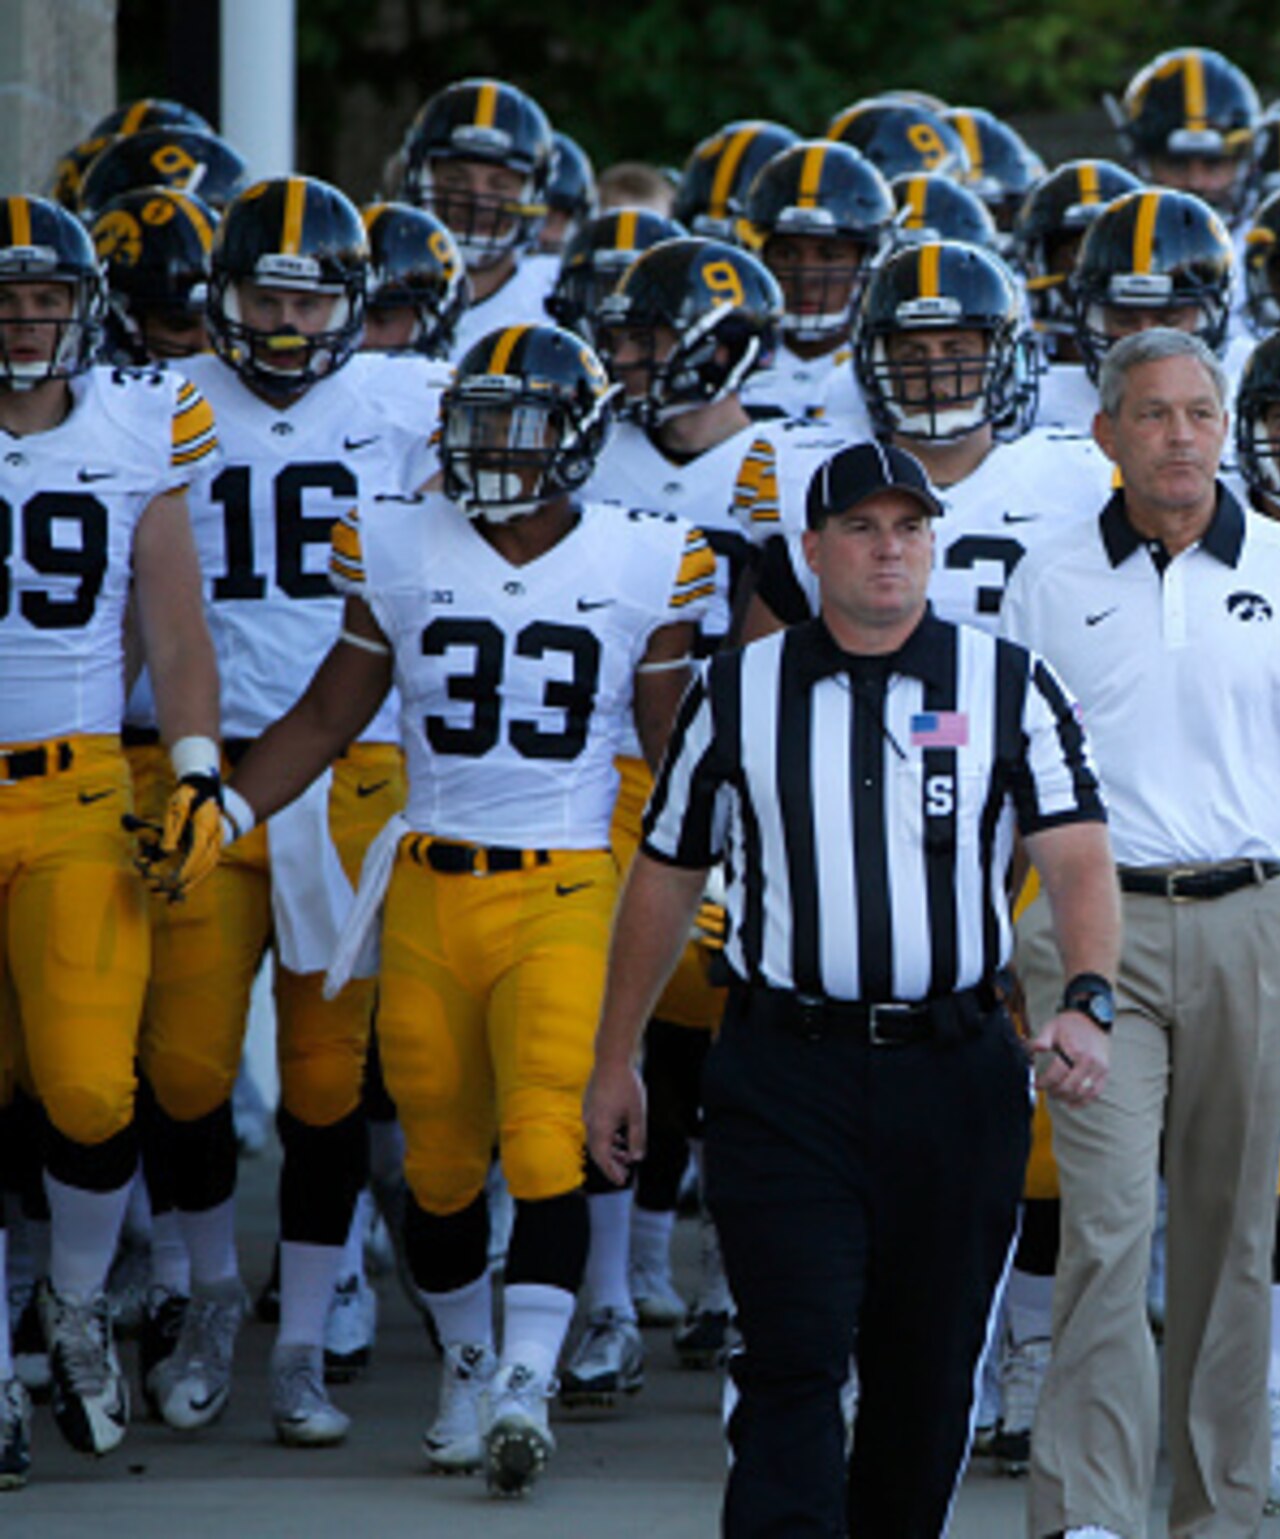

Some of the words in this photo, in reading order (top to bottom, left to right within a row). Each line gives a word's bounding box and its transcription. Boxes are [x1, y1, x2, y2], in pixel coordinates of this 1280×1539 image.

[908, 125, 948, 169] 9
[702, 260, 745, 308] 9
[0, 489, 109, 629] 9
[210, 461, 358, 599] 16
[421, 617, 602, 762] 33
[927, 775, 953, 816] S
